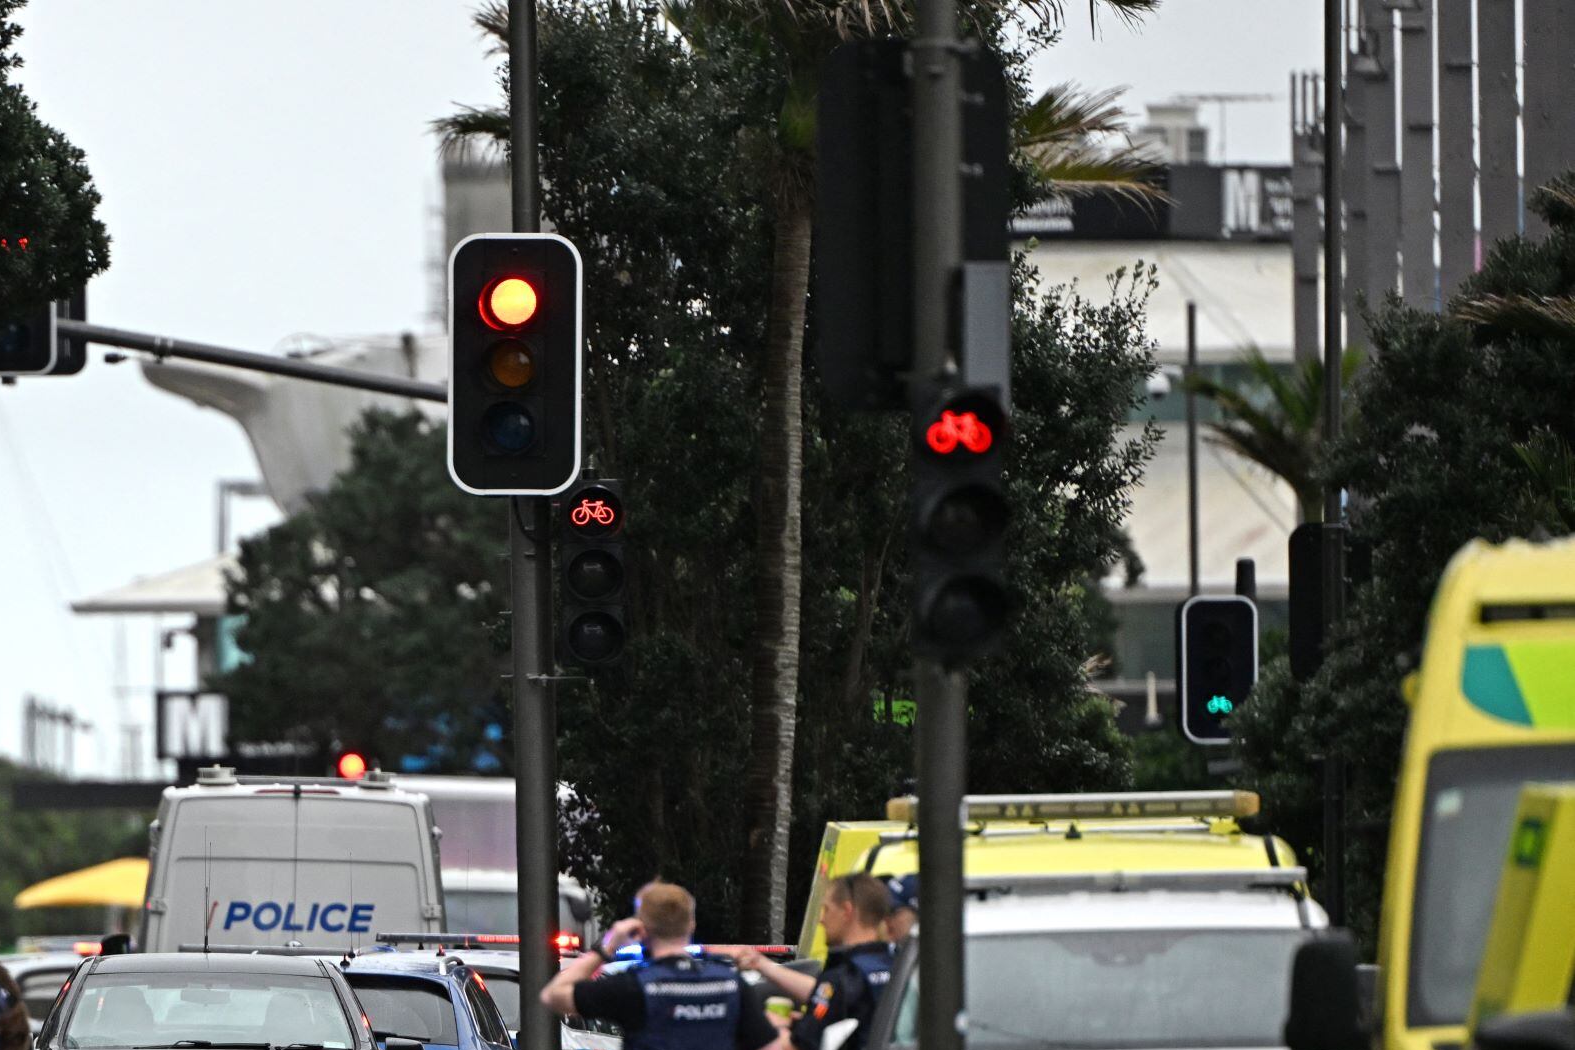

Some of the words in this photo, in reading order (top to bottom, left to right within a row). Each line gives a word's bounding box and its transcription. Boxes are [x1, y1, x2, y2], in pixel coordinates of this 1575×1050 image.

[164, 696, 228, 757] M
[223, 901, 375, 933] POLICE
[673, 1003, 727, 1020] POLICE
